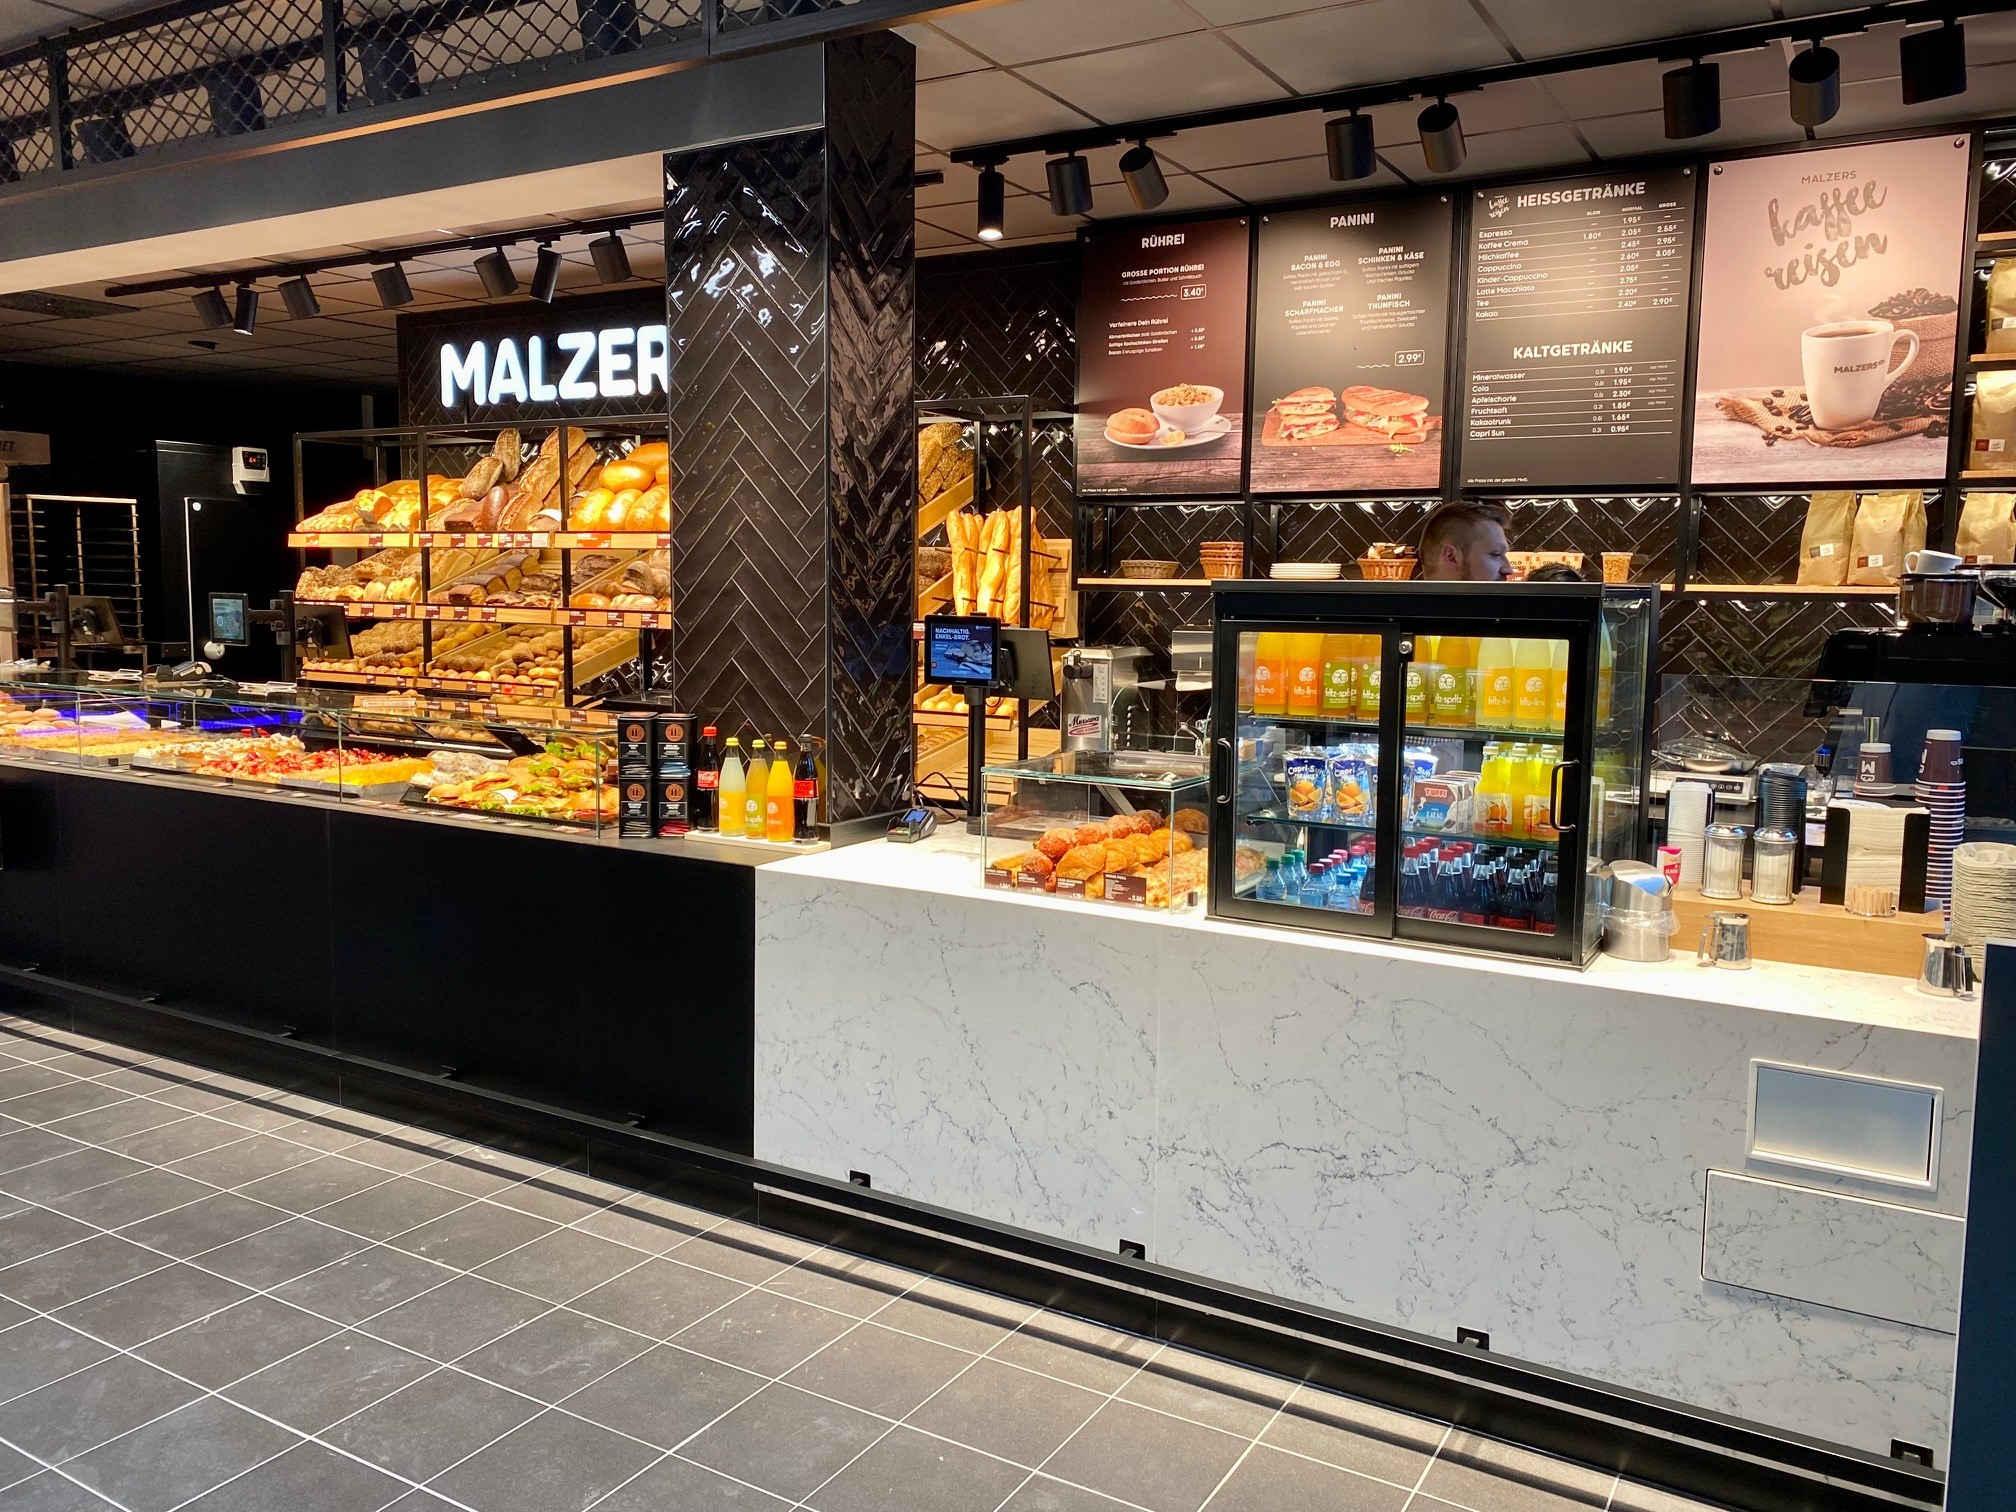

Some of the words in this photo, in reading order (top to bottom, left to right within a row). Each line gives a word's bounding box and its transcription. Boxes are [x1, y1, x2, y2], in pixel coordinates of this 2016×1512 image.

[1801, 170, 1857, 185] MALZERS
[1517, 182, 1646, 208] HEISSGETRÄNKE
[1767, 180, 1888, 247] kaffee
[1330, 213, 1375, 228] PANINI
[1141, 233, 1185, 249] RÜHREI
[1503, 239, 1529, 248] Crema
[1378, 245, 1404, 255] PANINI
[1304, 253, 1328, 262] PANINI
[1358, 254, 1396, 265] SCHINKEN
[1404, 251, 1424, 260] KÄSE
[1764, 232, 1888, 290] reisen
[1121, 269, 1148, 278] GROSSE
[1149, 266, 1179, 276] PORTION
[1180, 263, 1205, 272] RÜHREI
[1291, 261, 1318, 271] BACON
[1478, 263, 1522, 273] Cappuccino
[1477, 272, 1548, 284] Kinder-Cappuccino
[1376, 292, 1402, 301] PANINI
[1302, 298, 1327, 308] PANINI
[1368, 300, 1411, 310] THUNFISCH
[1284, 305, 1344, 317] SCHARFMACHER
[1475, 310, 1499, 318] Kakao
[1513, 340, 1633, 360] KALTGETRÄNKE
[1833, 361, 1878, 374] MALZERS
[1472, 372, 1526, 381] Mineralwasser
[1471, 395, 1517, 404] Apfelschorle
[1471, 407, 1508, 415] Fruchtsaft
[1470, 418, 1512, 426] Kakaotrunk
[1470, 430, 1490, 438] Capri
[1491, 429, 1505, 437] Sun
